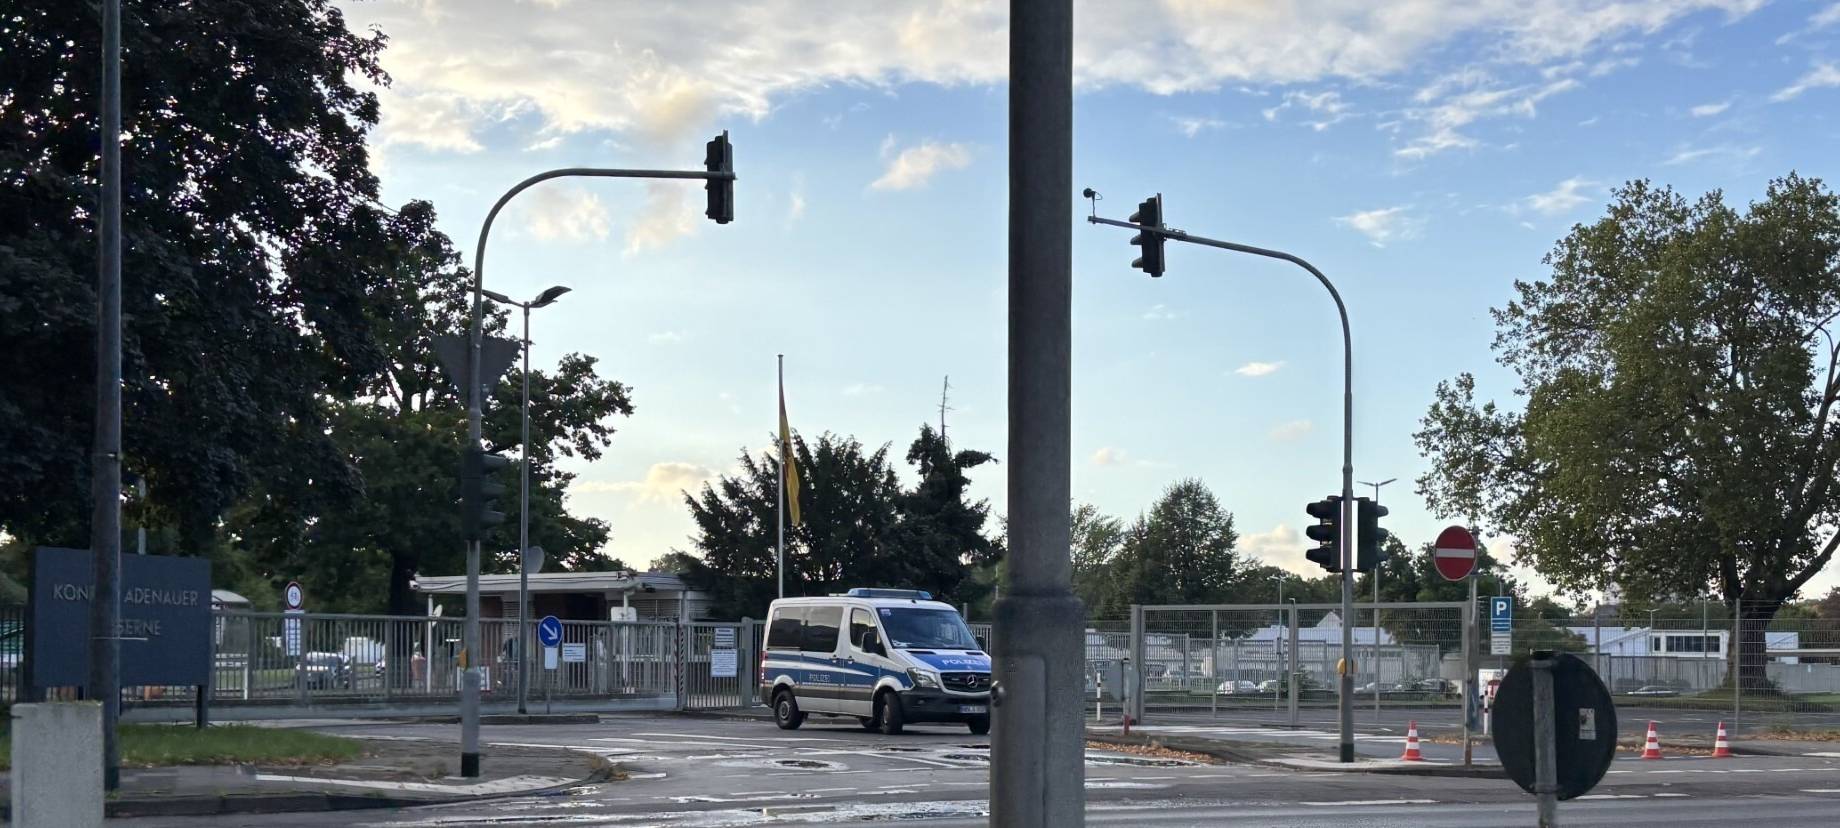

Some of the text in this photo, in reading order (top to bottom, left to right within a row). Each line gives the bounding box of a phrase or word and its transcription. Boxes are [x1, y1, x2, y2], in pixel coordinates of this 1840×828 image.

[53, 584, 198, 606] KON ADENAUER
[1496, 601, 1507, 616] P
[942, 658, 985, 666] POLIZEI
